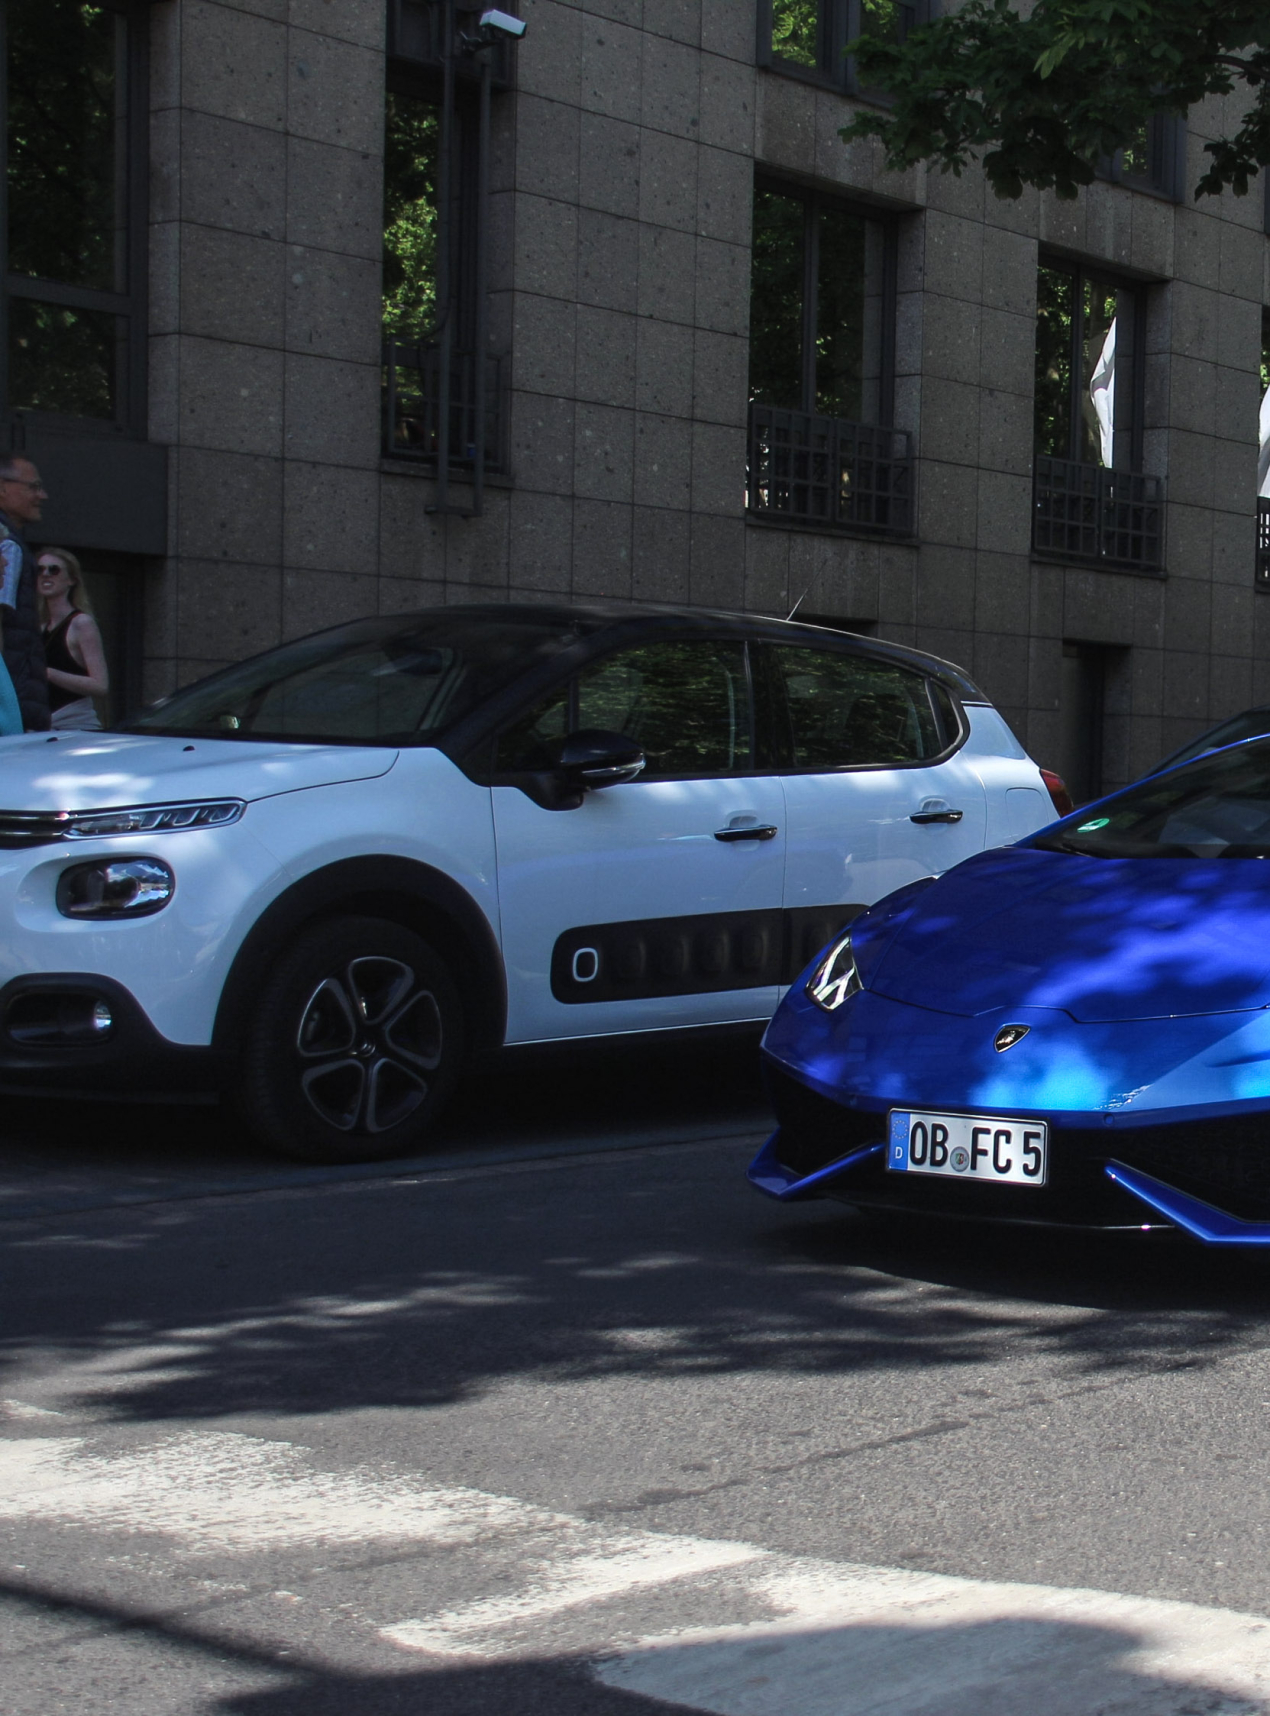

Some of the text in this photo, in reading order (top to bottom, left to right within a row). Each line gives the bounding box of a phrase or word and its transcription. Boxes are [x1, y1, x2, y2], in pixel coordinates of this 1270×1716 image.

[894, 1146, 903, 1159] D
[909, 1121, 1042, 1176] OB FC 5
